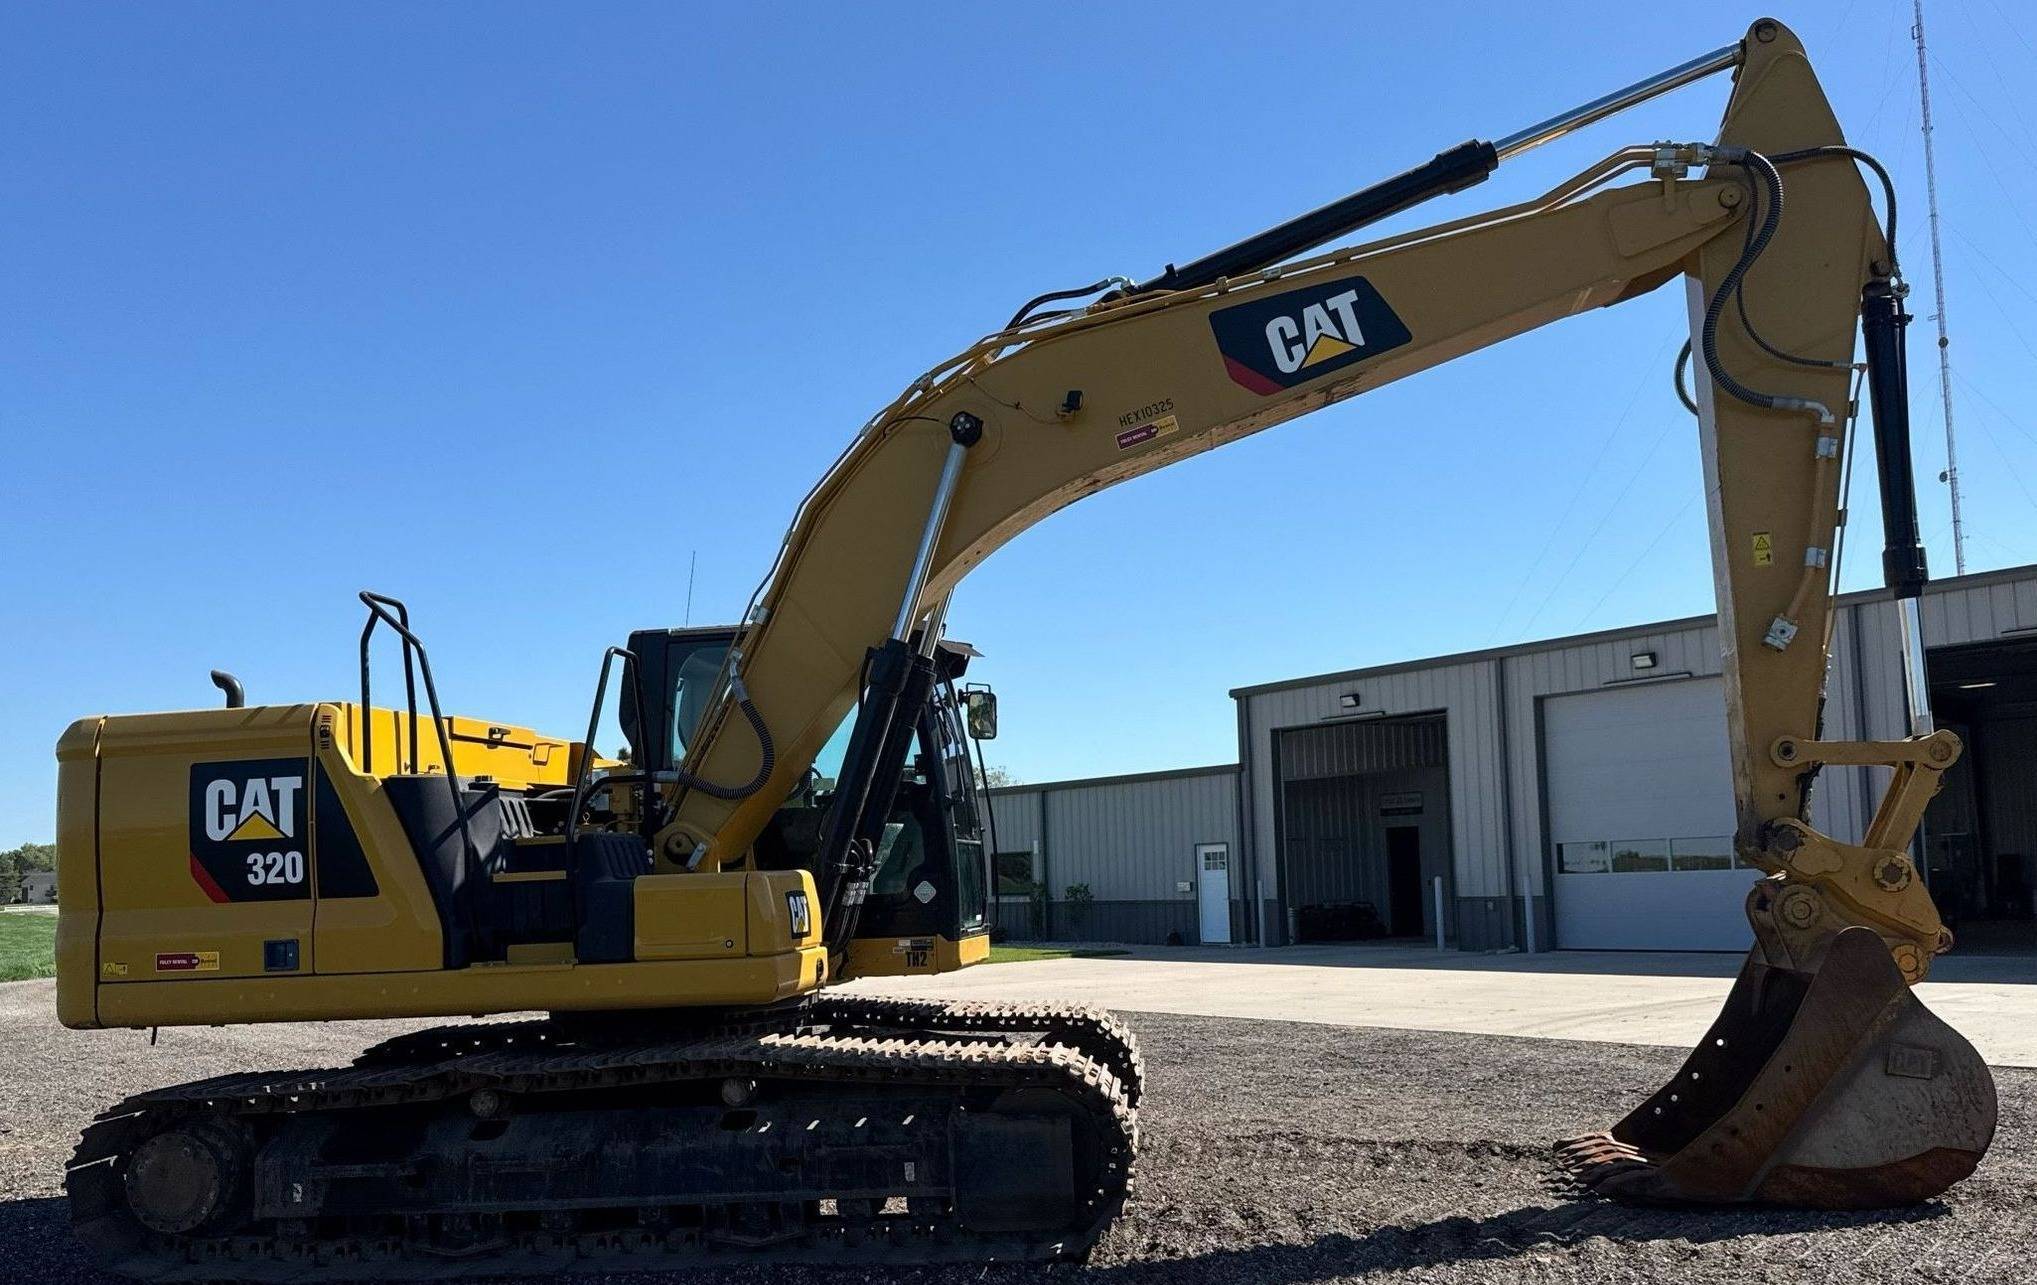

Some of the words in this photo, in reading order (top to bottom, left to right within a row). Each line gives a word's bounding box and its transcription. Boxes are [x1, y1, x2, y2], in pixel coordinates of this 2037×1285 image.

[1265, 289, 1366, 374] CAT
[1118, 398, 1174, 427] HEX10325
[206, 776, 302, 842] CAT
[246, 850, 304, 886] 320
[789, 895, 809, 934] CAT
